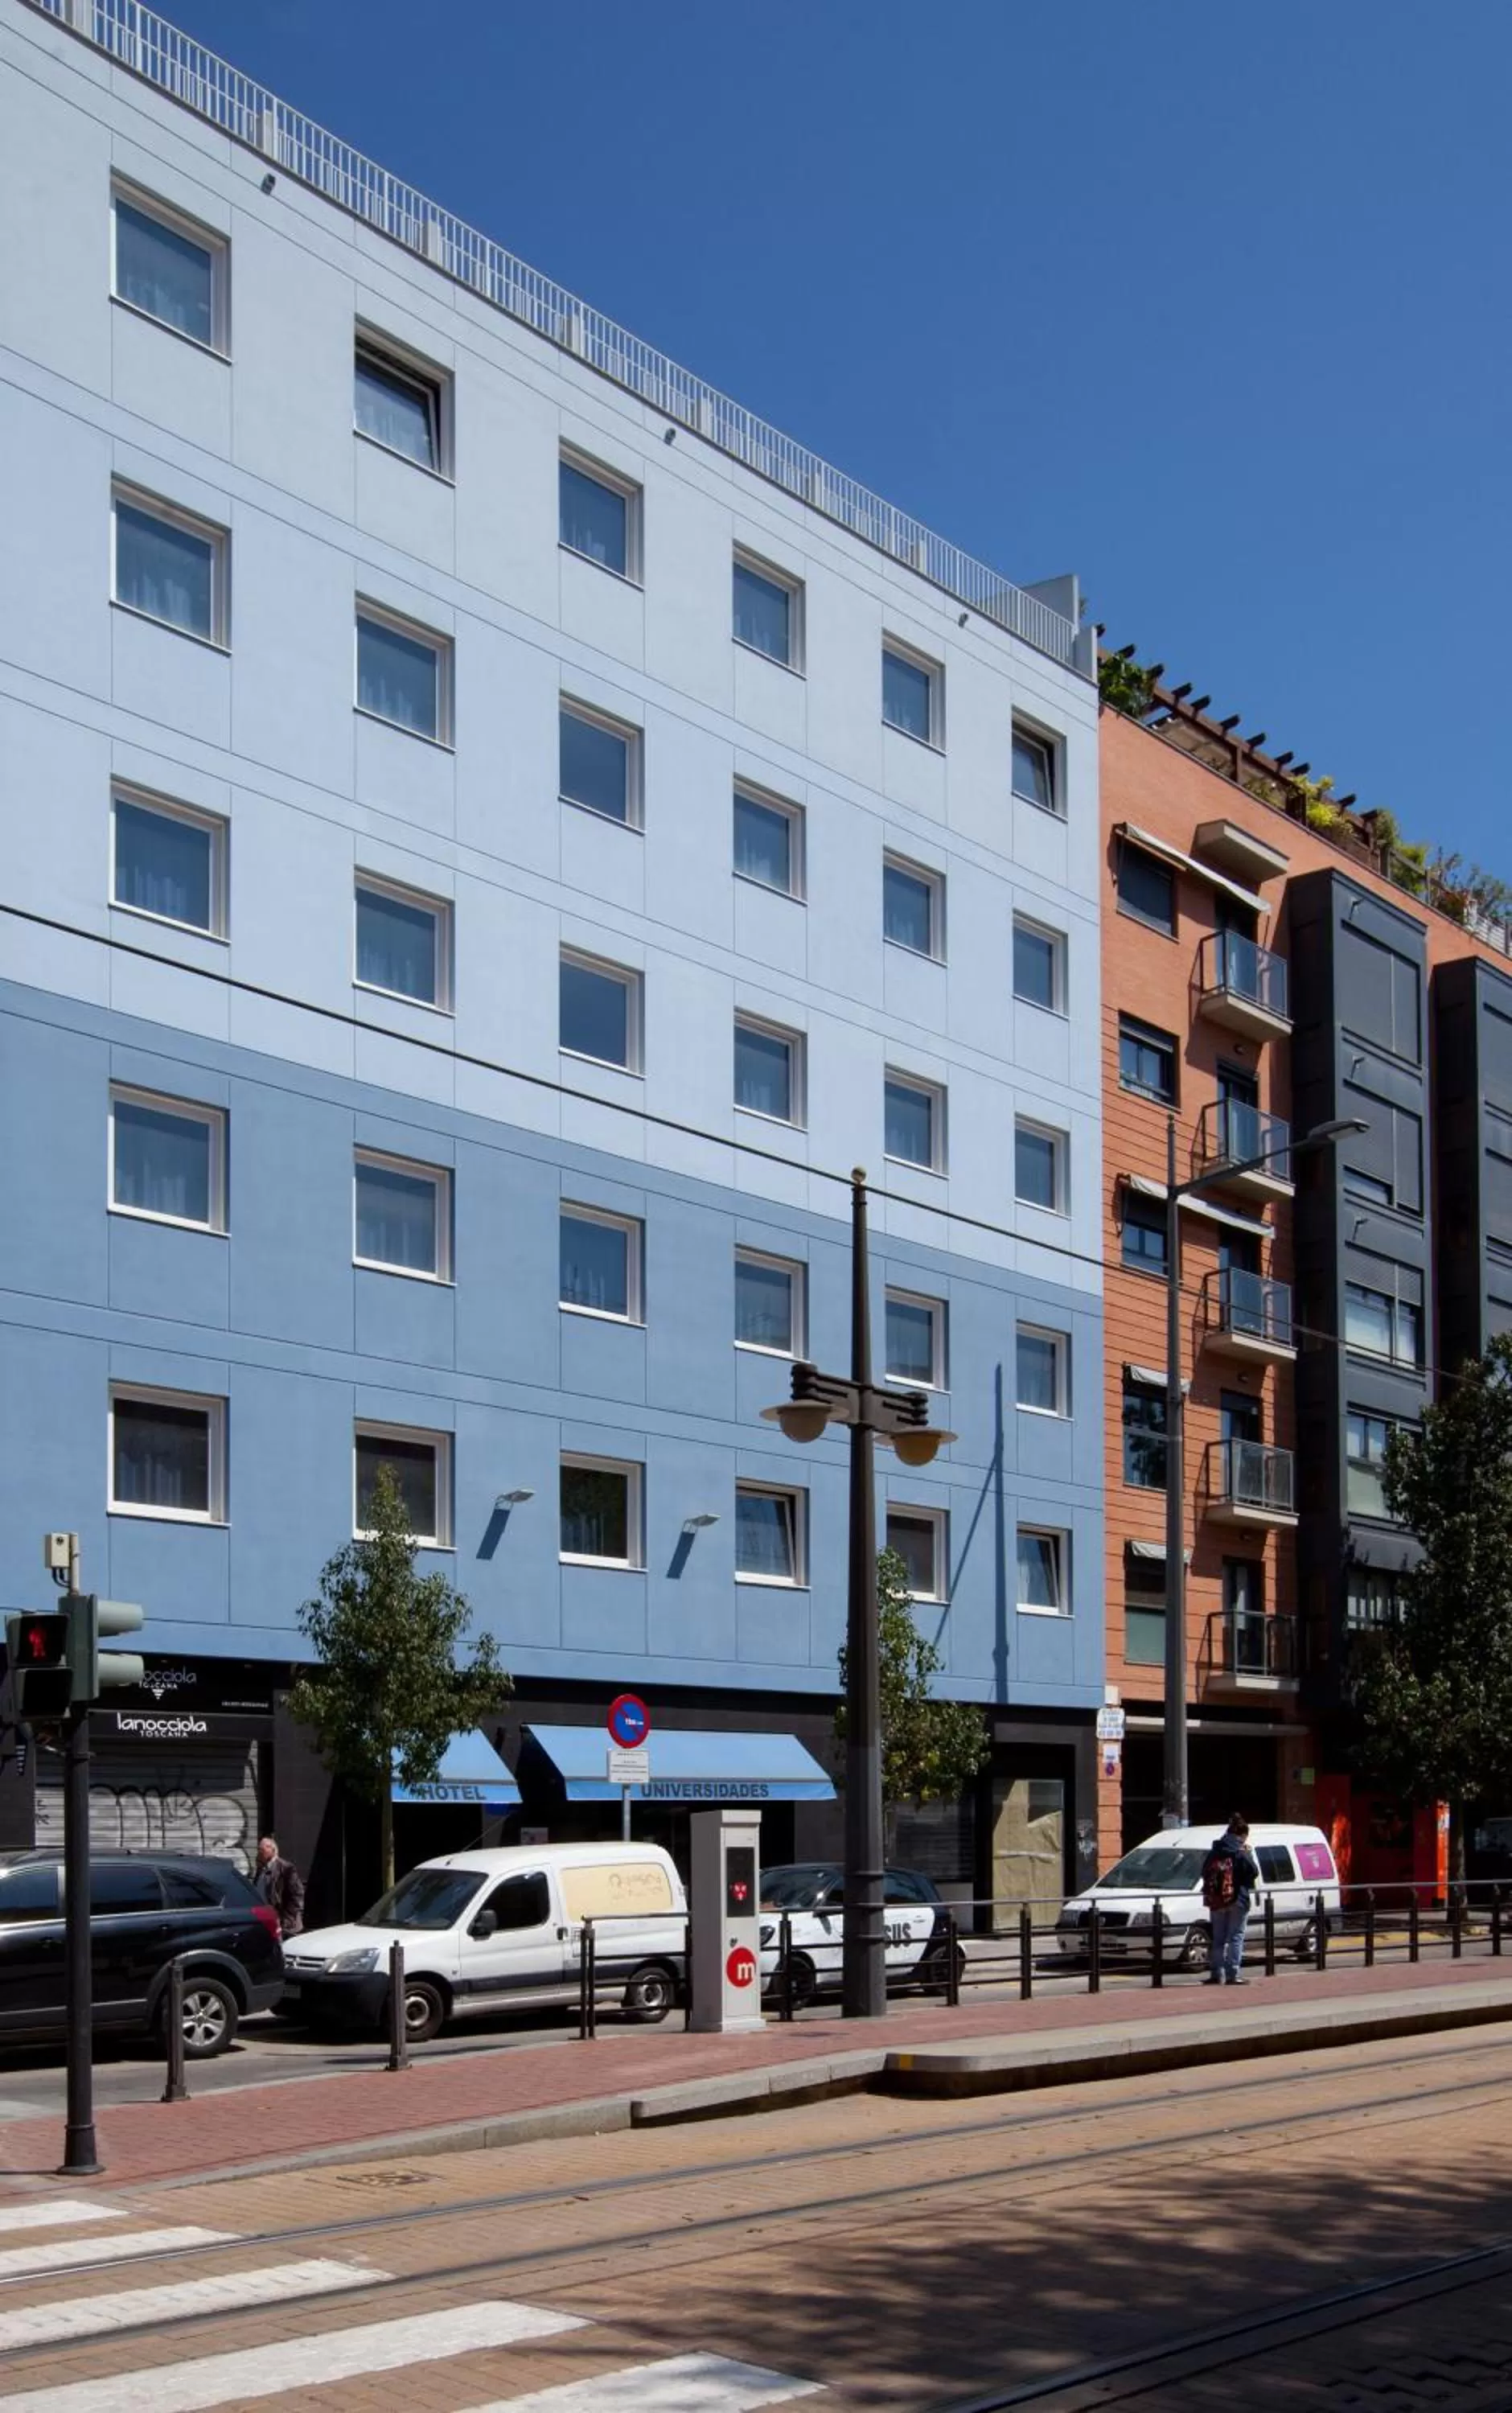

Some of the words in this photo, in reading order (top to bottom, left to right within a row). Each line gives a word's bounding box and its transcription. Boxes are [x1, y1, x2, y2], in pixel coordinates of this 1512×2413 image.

[142, 1666, 197, 1683] occiola
[117, 1712, 207, 1732] lanocciola
[140, 1730, 189, 1738] TOSCANA
[422, 1784, 487, 1801] HOTEL
[642, 1782, 770, 1798] UNIVERSIDADES
